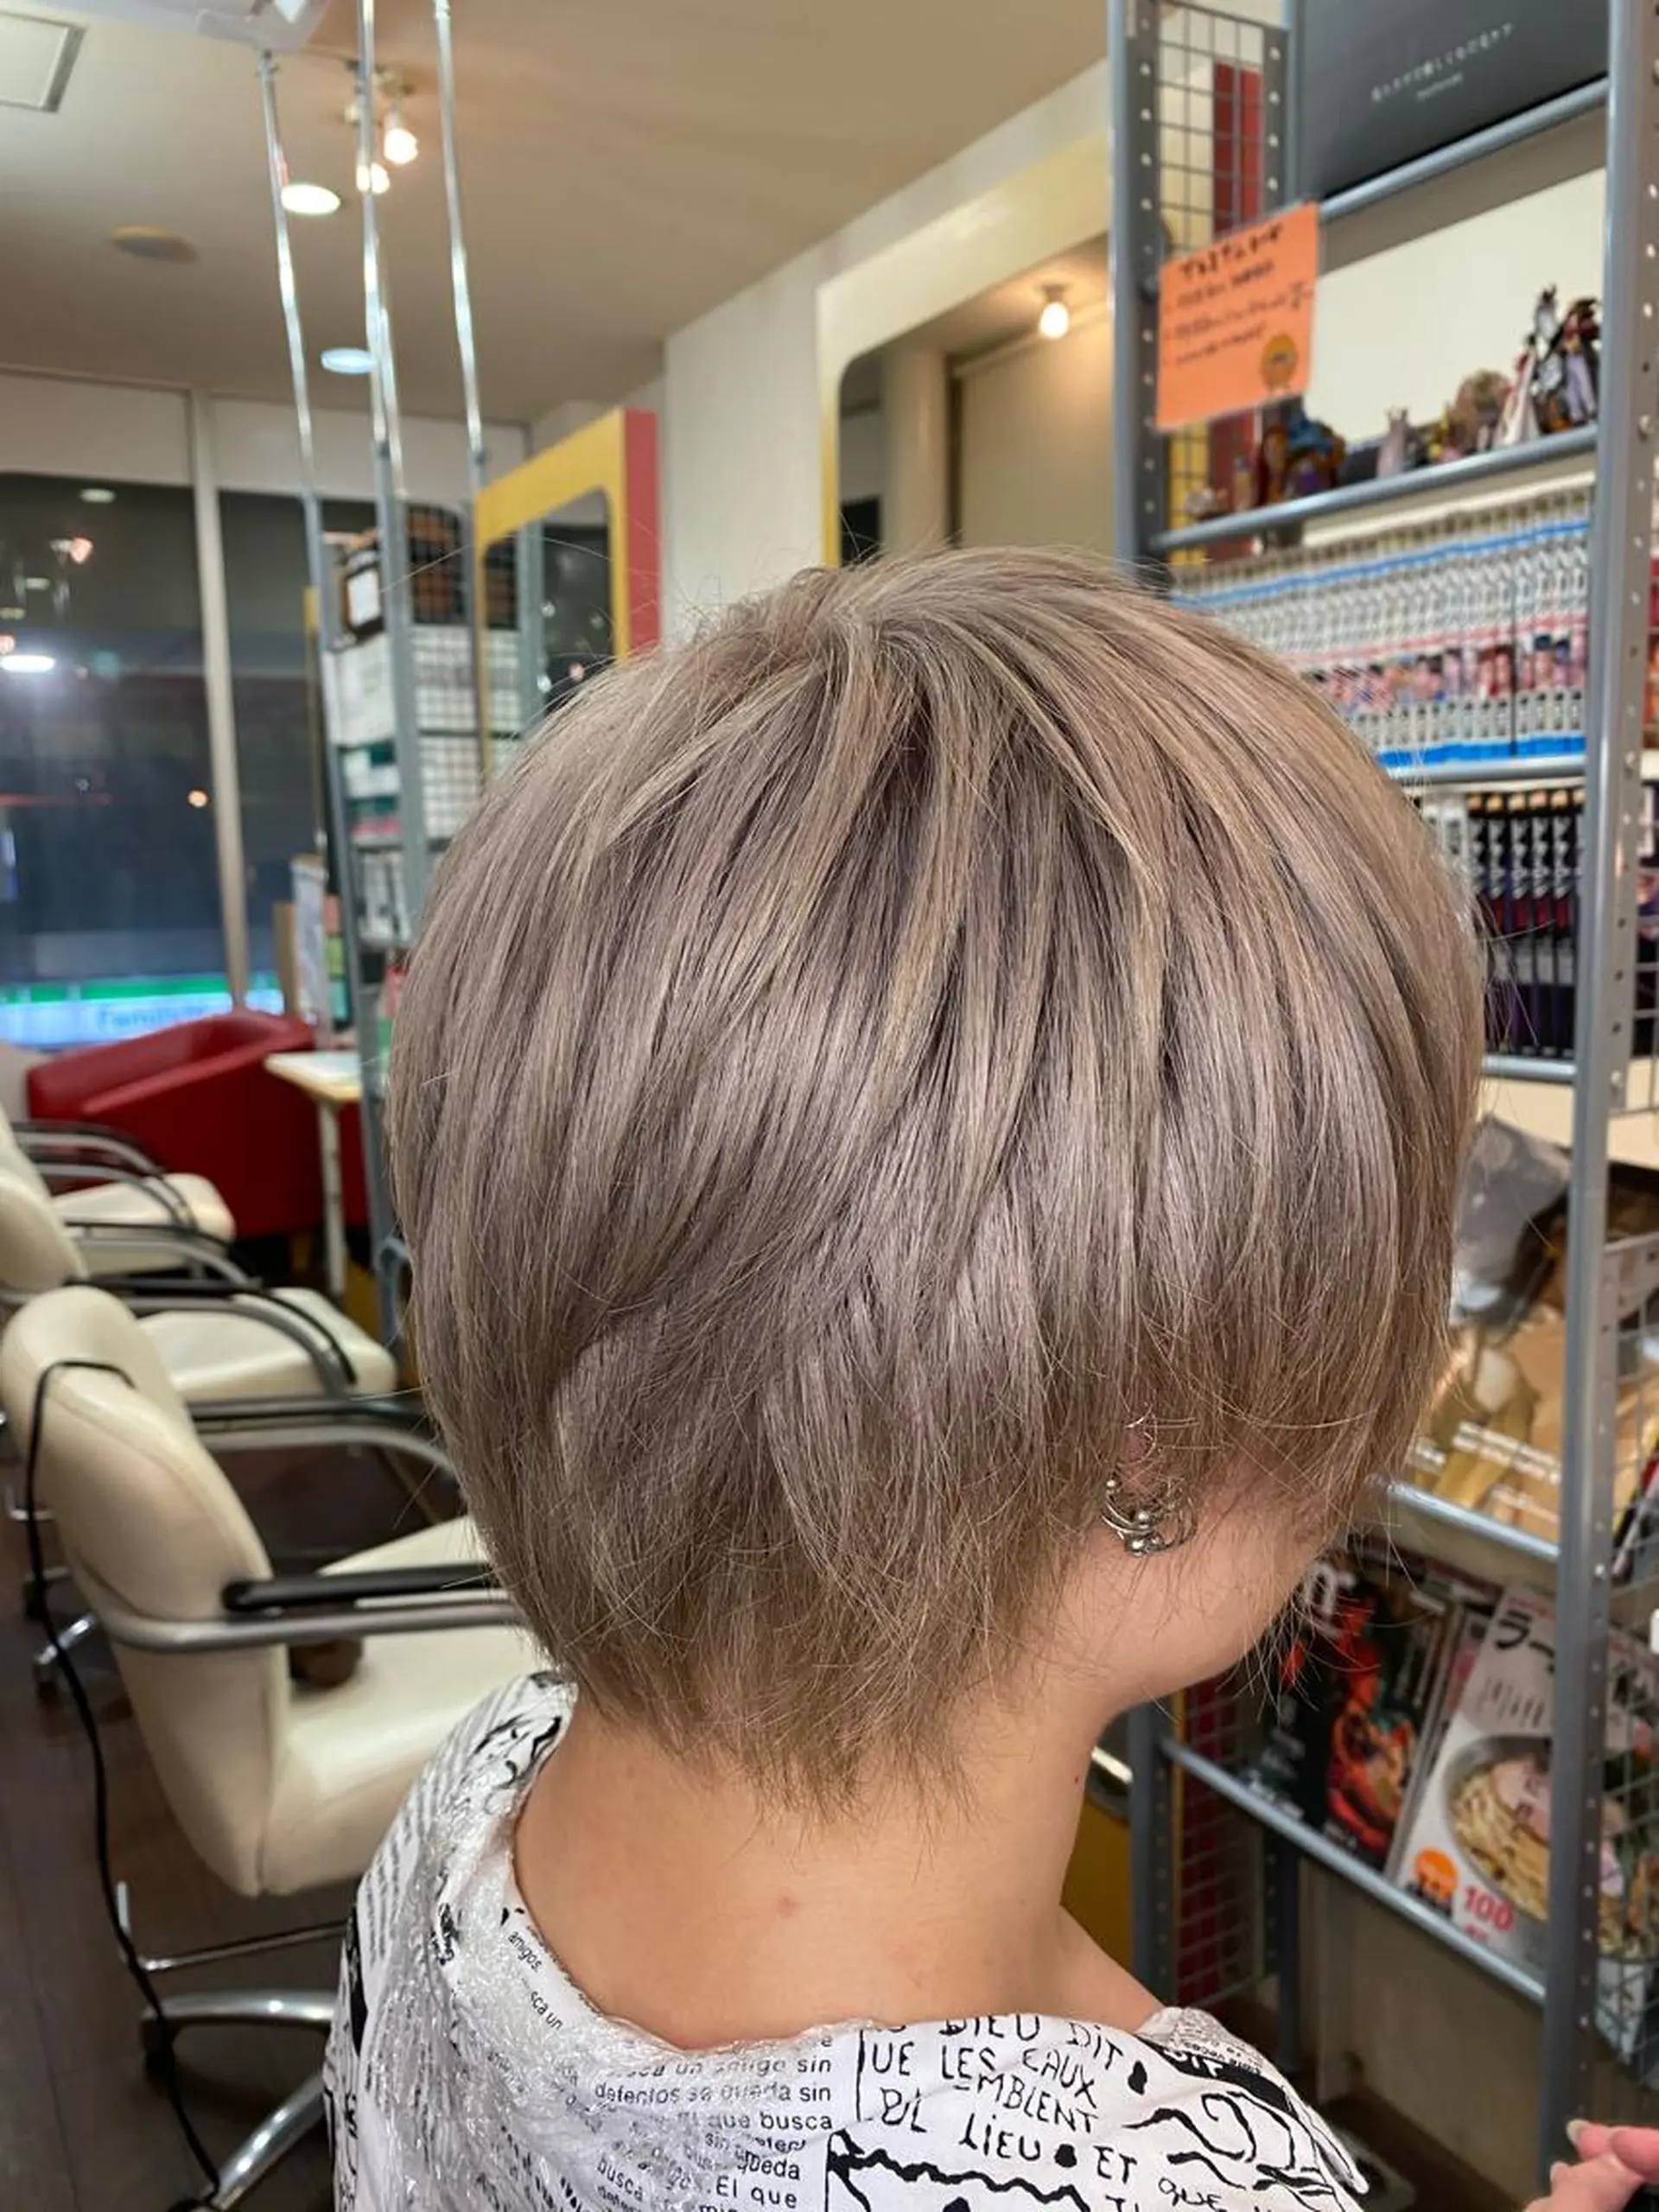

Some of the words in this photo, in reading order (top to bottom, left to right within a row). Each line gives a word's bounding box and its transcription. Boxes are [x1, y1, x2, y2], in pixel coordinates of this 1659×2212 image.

[797, 2056, 832, 2073] sin
[799, 2085, 832, 2101] sin
[760, 2110, 833, 2131] busca
[750, 2186, 798, 2209] que
